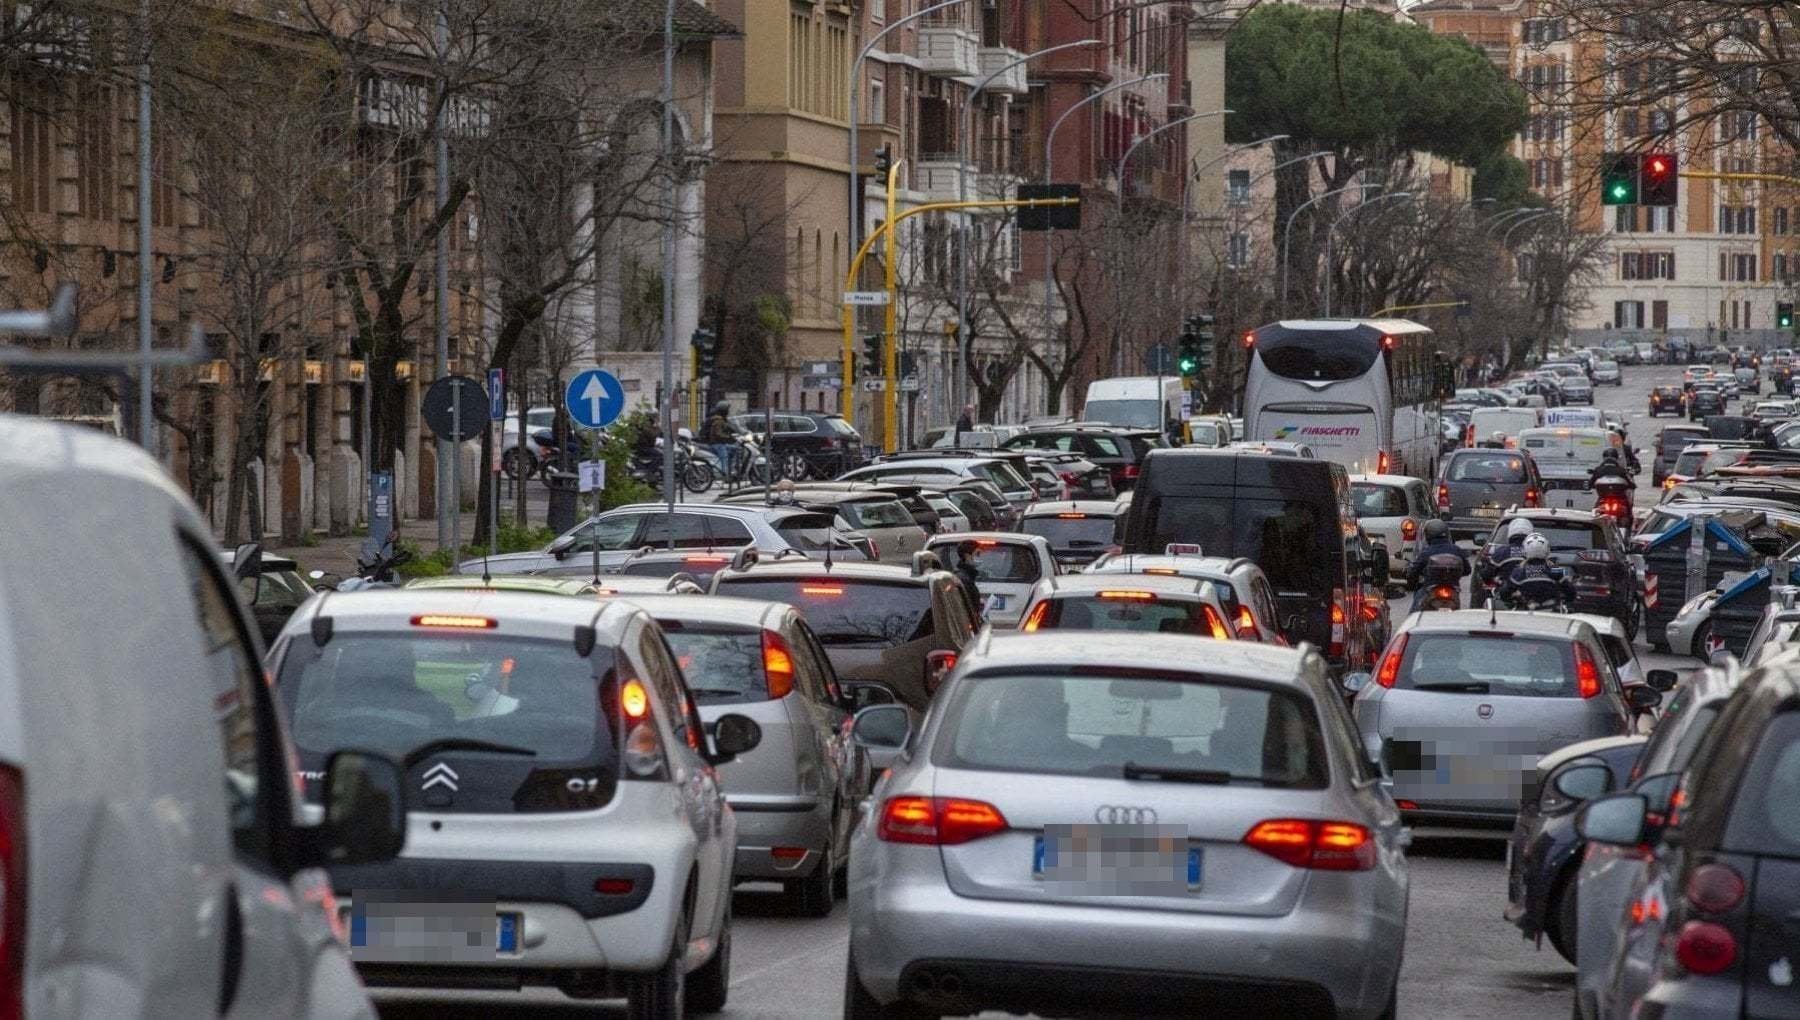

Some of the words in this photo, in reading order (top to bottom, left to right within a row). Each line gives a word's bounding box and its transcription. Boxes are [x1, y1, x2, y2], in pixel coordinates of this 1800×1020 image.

[1301, 427, 1360, 436] FIASCHETTI
[379, 476, 387, 488] P
[566, 778, 598, 792] C1
